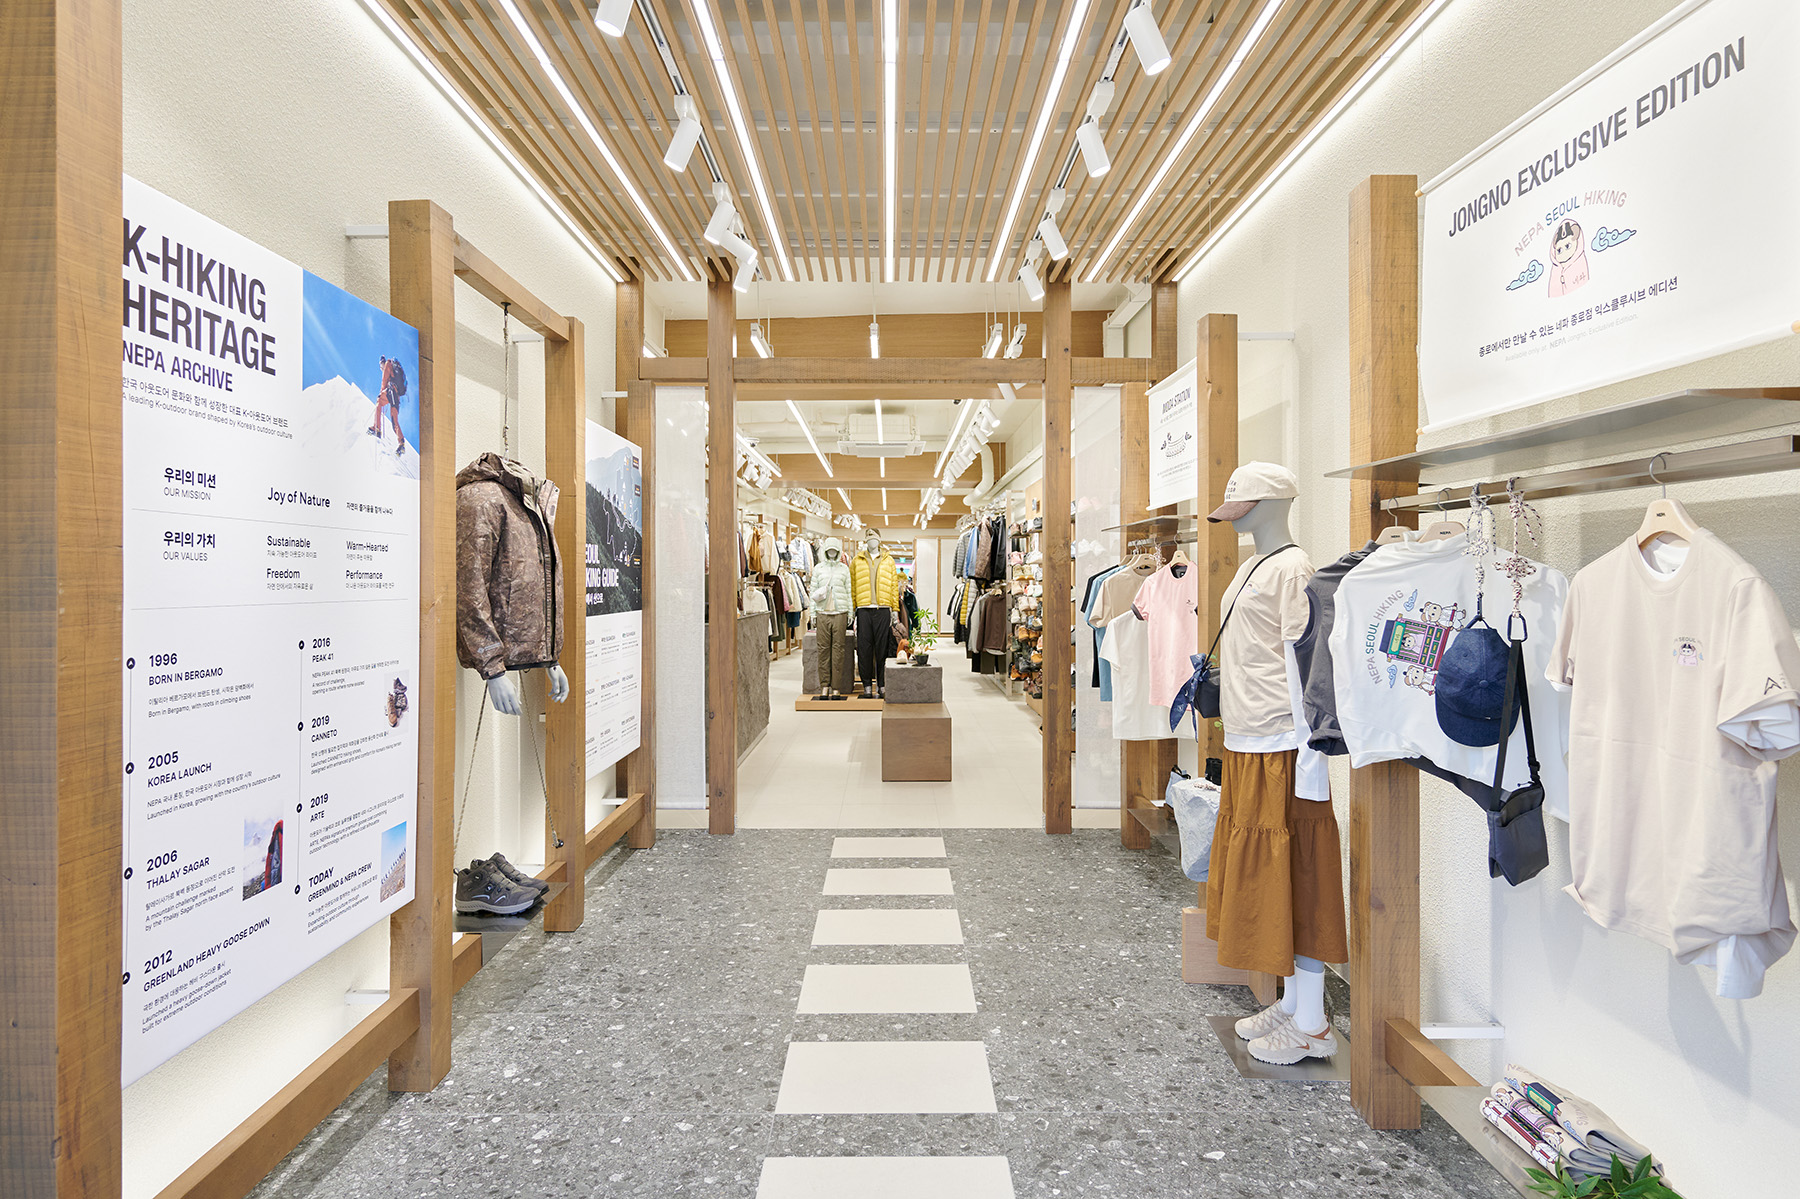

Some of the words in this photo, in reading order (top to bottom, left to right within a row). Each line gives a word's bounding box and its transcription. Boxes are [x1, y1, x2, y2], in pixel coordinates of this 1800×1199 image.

[1449, 179, 1511, 238] JONGNO
[1518, 107, 1628, 197] EXCLUSIVE
[1636, 35, 1745, 129] EDITION
[1514, 222, 1544, 257] NEPA
[1545, 196, 1580, 226] SEOUL
[1584, 190, 1627, 208] HIKING
[122, 217, 266, 323] K-HIKING
[122, 277, 276, 376] HERITAGE
[1479, 338, 1511, 358] 종로에서만
[1512, 333, 1527, 346] 만날
[1529, 329, 1537, 340] 수
[1539, 323, 1554, 337] 있는
[1555, 317, 1569, 331] 네파
[1570, 307, 1593, 327] 종로점
[1594, 288, 1646, 316] 익스클루시브
[1648, 276, 1678, 297] 에디션
[1549, 337, 1566, 349] NEPA
[122, 339, 165, 373] NEPA
[170, 355, 232, 392] ARCHIVE
[128, 393, 154, 408] leading
[154, 399, 187, 414] K-outdoor
[188, 408, 206, 419] brand
[207, 413, 228, 424] shaped
[237, 420, 256, 431] Korea's
[256, 425, 276, 435] outdoor
[276, 430, 292, 439] culture
[163, 467, 194, 486] 우리의
[197, 472, 215, 488] 미션
[163, 486, 180, 497] OUR
[181, 489, 210, 500] MISSION
[267, 487, 285, 505] Joy
[287, 490, 297, 503] of
[299, 491, 330, 507] Nature
[163, 530, 193, 547] 우리의
[196, 532, 215, 548] 가치
[266, 535, 310, 548] Sustainable
[346, 540, 388, 552] Warm-Hearted
[162, 550, 179, 560] OUR
[180, 552, 208, 561] VALUES
[586, 543, 600, 564] EOUL
[266, 567, 300, 578] Freedom
[345, 569, 382, 579] Performance
[586, 567, 601, 588] KING
[602, 568, 619, 587] GUIDE
[1373, 589, 1404, 621] HIKING
[312, 637, 330, 648] 2016
[1365, 622, 1380, 654] SEOUL
[148, 652, 177, 667] 1996
[312, 653, 326, 662] PEAK
[148, 673, 172, 685] BORN
[174, 672, 182, 682] IN
[184, 667, 223, 680] BERGAMO
[1367, 656, 1383, 685] NEPA
[311, 714, 329, 728] 2019
[310, 728, 337, 742] CANNETO
[148, 750, 178, 769] 2005
[147, 771, 176, 787] KOREA
[178, 762, 211, 779] LAUNCH
[310, 792, 328, 808] 2019
[309, 809, 324, 822] ARTE
[146, 849, 177, 872] 2006
[146, 867, 181, 889] THALAY
[182, 856, 209, 875] SAGAR
[307, 879, 339, 902] GREENMIND
[339, 877, 343, 885] &
[344, 870, 357, 882] NEPA
[357, 862, 372, 875] CREW
[308, 866, 334, 887] TODAY
[143, 957, 194, 992] GREENLAND
[195, 942, 222, 964] HEAVY
[222, 928, 247, 948] GOOSE
[248, 916, 270, 935] DOWN
[144, 949, 172, 974] 2012
